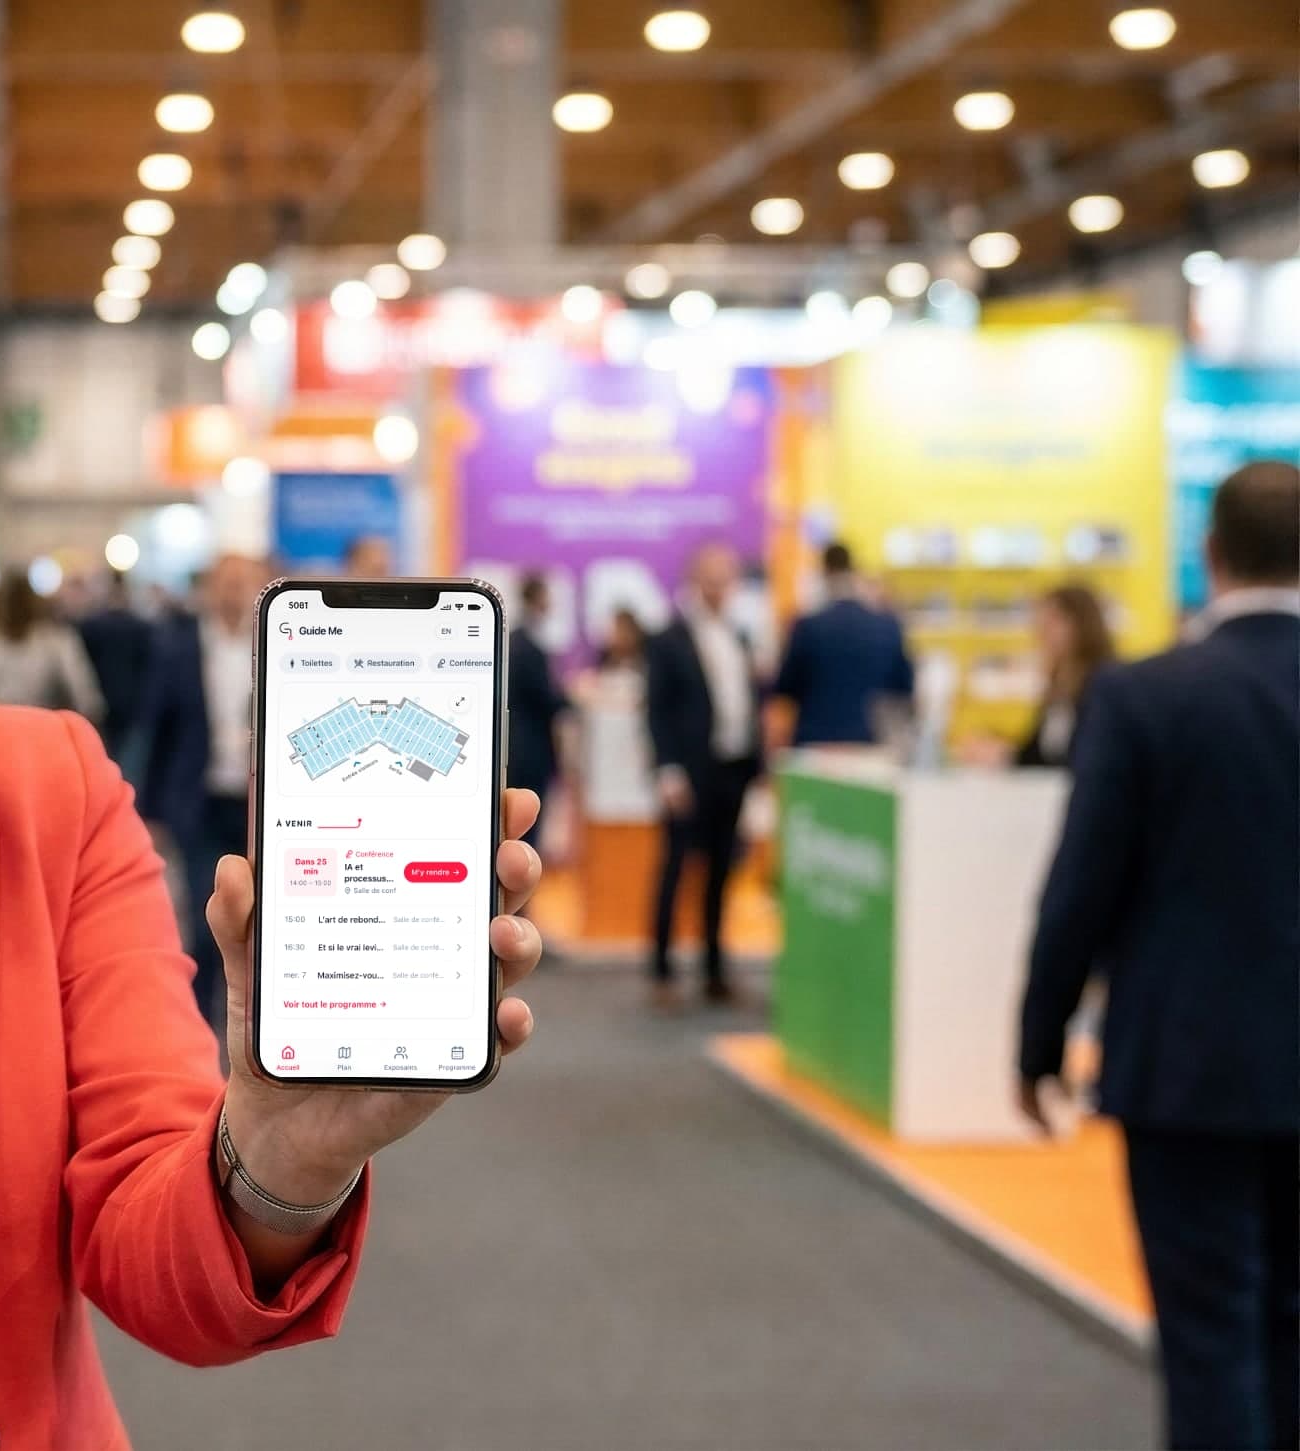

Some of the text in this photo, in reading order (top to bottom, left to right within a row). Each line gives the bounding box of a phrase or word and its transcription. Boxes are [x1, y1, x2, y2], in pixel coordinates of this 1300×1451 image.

[299, 626, 343, 636] Guide Me
[301, 659, 333, 667] Toilettes
[367, 659, 415, 667] Restauration
[449, 659, 493, 667] Conférence
[355, 850, 394, 858] Conférence
[295, 858, 327, 866] Dans 25
[303, 867, 319, 875] min
[318, 916, 337, 924] L'art
[301, 971, 307, 979] 7
[283, 1001, 377, 1010] Voir tout le programme
[276, 1063, 300, 1071] Accueil
[337, 1063, 352, 1071] Plan
[438, 1064, 477, 1072] Programme
